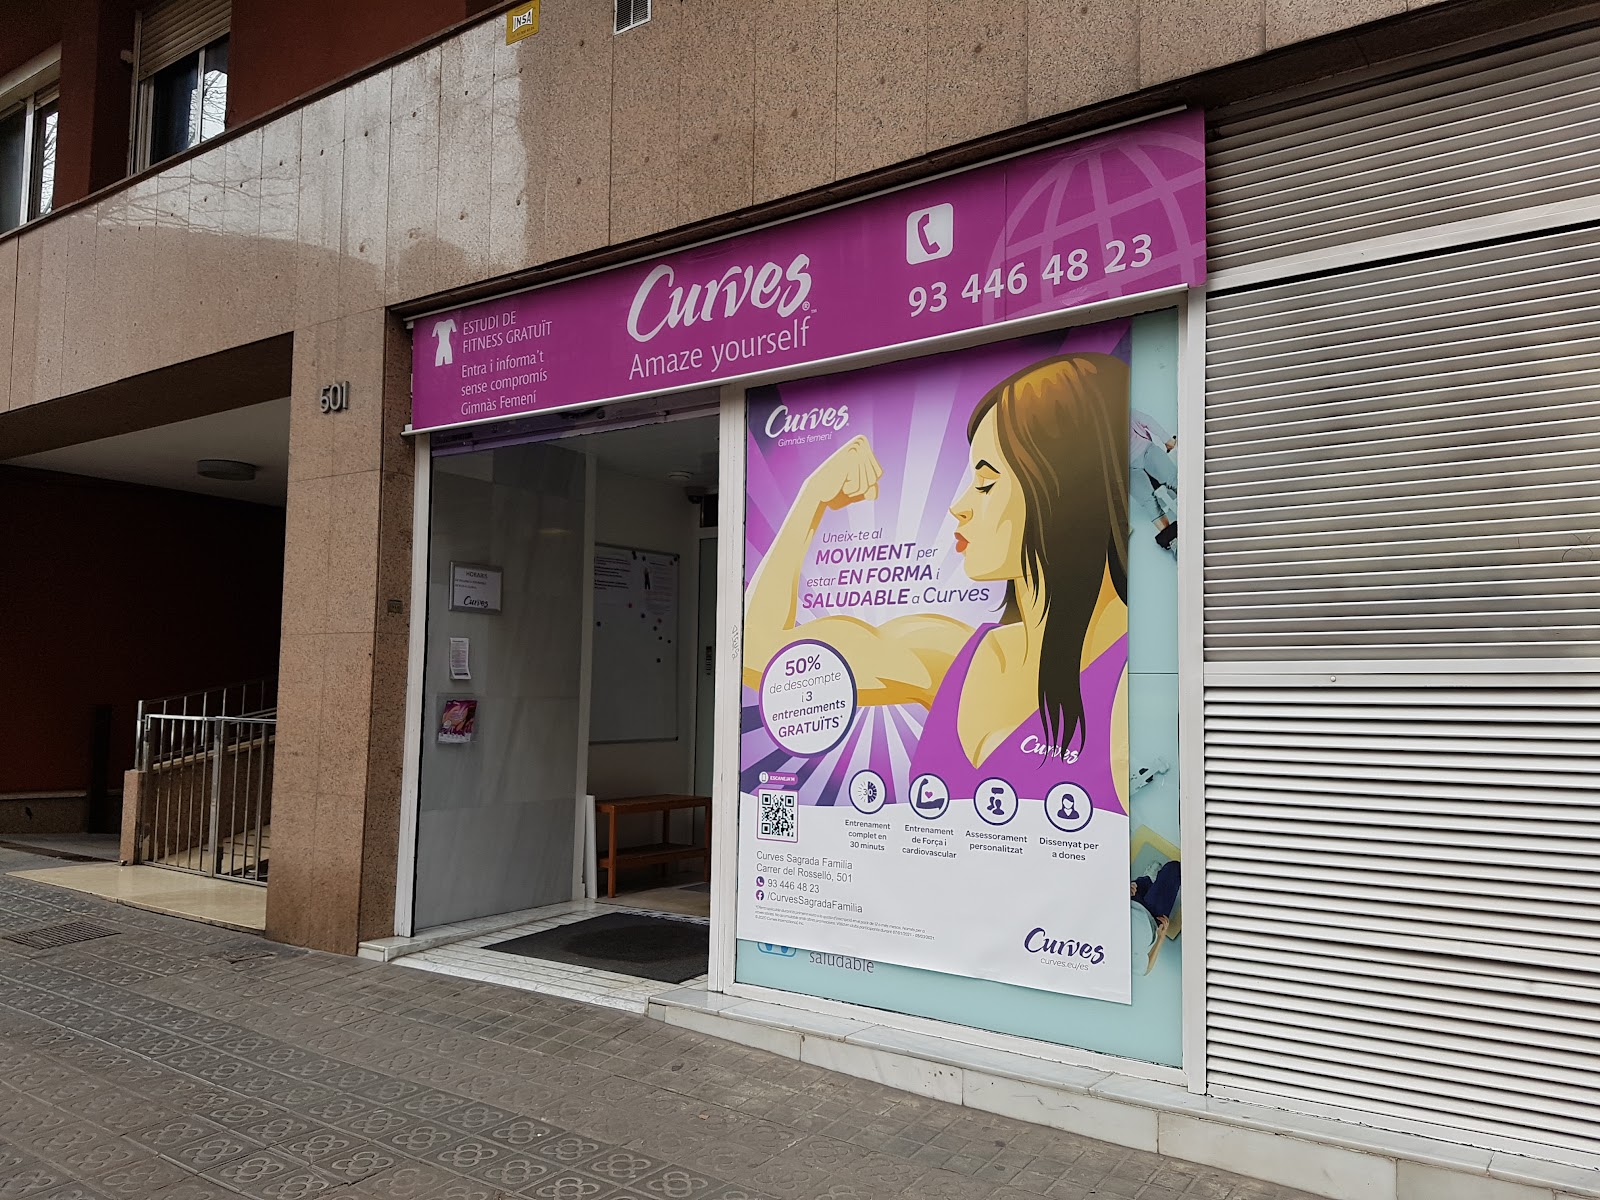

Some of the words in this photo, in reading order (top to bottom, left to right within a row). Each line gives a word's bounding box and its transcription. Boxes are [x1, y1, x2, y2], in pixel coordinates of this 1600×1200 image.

[514, 11, 531, 29] INSA
[908, 281, 947, 318] 93
[961, 262, 1028, 304] 446
[1041, 248, 1088, 286] 48
[1104, 234, 1152, 274] 23
[626, 254, 812, 342] Curves
[462, 314, 499, 335] ESTUDI
[502, 311, 516, 326] DE
[462, 332, 503, 353] FITNESS
[506, 320, 553, 344] GRATUÏT
[629, 346, 702, 380] Amaze
[711, 316, 811, 373] yourself
[461, 364, 487, 378] Entra
[490, 359, 493, 372] i
[496, 350, 544, 371] informa't
[460, 382, 487, 397] sense
[490, 368, 547, 391] compromís
[320, 381, 349, 413] 501
[461, 398, 497, 415] Gimnàs
[500, 390, 537, 409] Femení
[765, 404, 849, 439] Curves
[778, 435, 806, 447] Gimnàs
[806, 431, 832, 443] femení
[822, 530, 870, 544] Uneix-te
[872, 528, 883, 541] al
[815, 543, 916, 565] MOVIMENT
[916, 547, 938, 562] per
[806, 574, 837, 588] estar
[837, 569, 863, 586] EN
[866, 564, 933, 584] FORMA
[935, 568, 940, 580] i
[802, 588, 910, 609] SALUDABLE
[911, 593, 920, 605] a
[922, 586, 990, 604] Curves
[785, 654, 821, 676] 50%
[769, 682, 782, 694] de
[783, 671, 842, 691] descompte
[805, 691, 813, 702] 3
[772, 700, 846, 721] entrenaments
[845, 819, 891, 830] Entrenament
[904, 824, 954, 836] Entrenament
[848, 831, 877, 840] complet
[912, 836, 921, 844] de
[922, 837, 943, 847] Força
[965, 830, 1028, 843] Assessorament
[1039, 837, 1082, 849] Dissenyat
[1083, 842, 1099, 851] per
[860, 842, 885, 851] minuts
[902, 847, 957, 858] cardiovascular
[969, 843, 1024, 855] personalitzat
[1058, 851, 1086, 861] dones
[756, 850, 784, 862] Curves
[786, 853, 820, 866] Sagrada
[756, 862, 781, 874] Carrer
[783, 866, 796, 876] del
[797, 867, 834, 882] Rosselló,
[836, 872, 852, 883] 501
[767, 878, 778, 888] 93
[779, 880, 795, 890] 446
[796, 882, 808, 892] 48
[809, 883, 820, 893] 23
[1024, 927, 1103, 964] Curves
[809, 951, 875, 973] saludable
[1040, 958, 1089, 970] curves.eu/es
